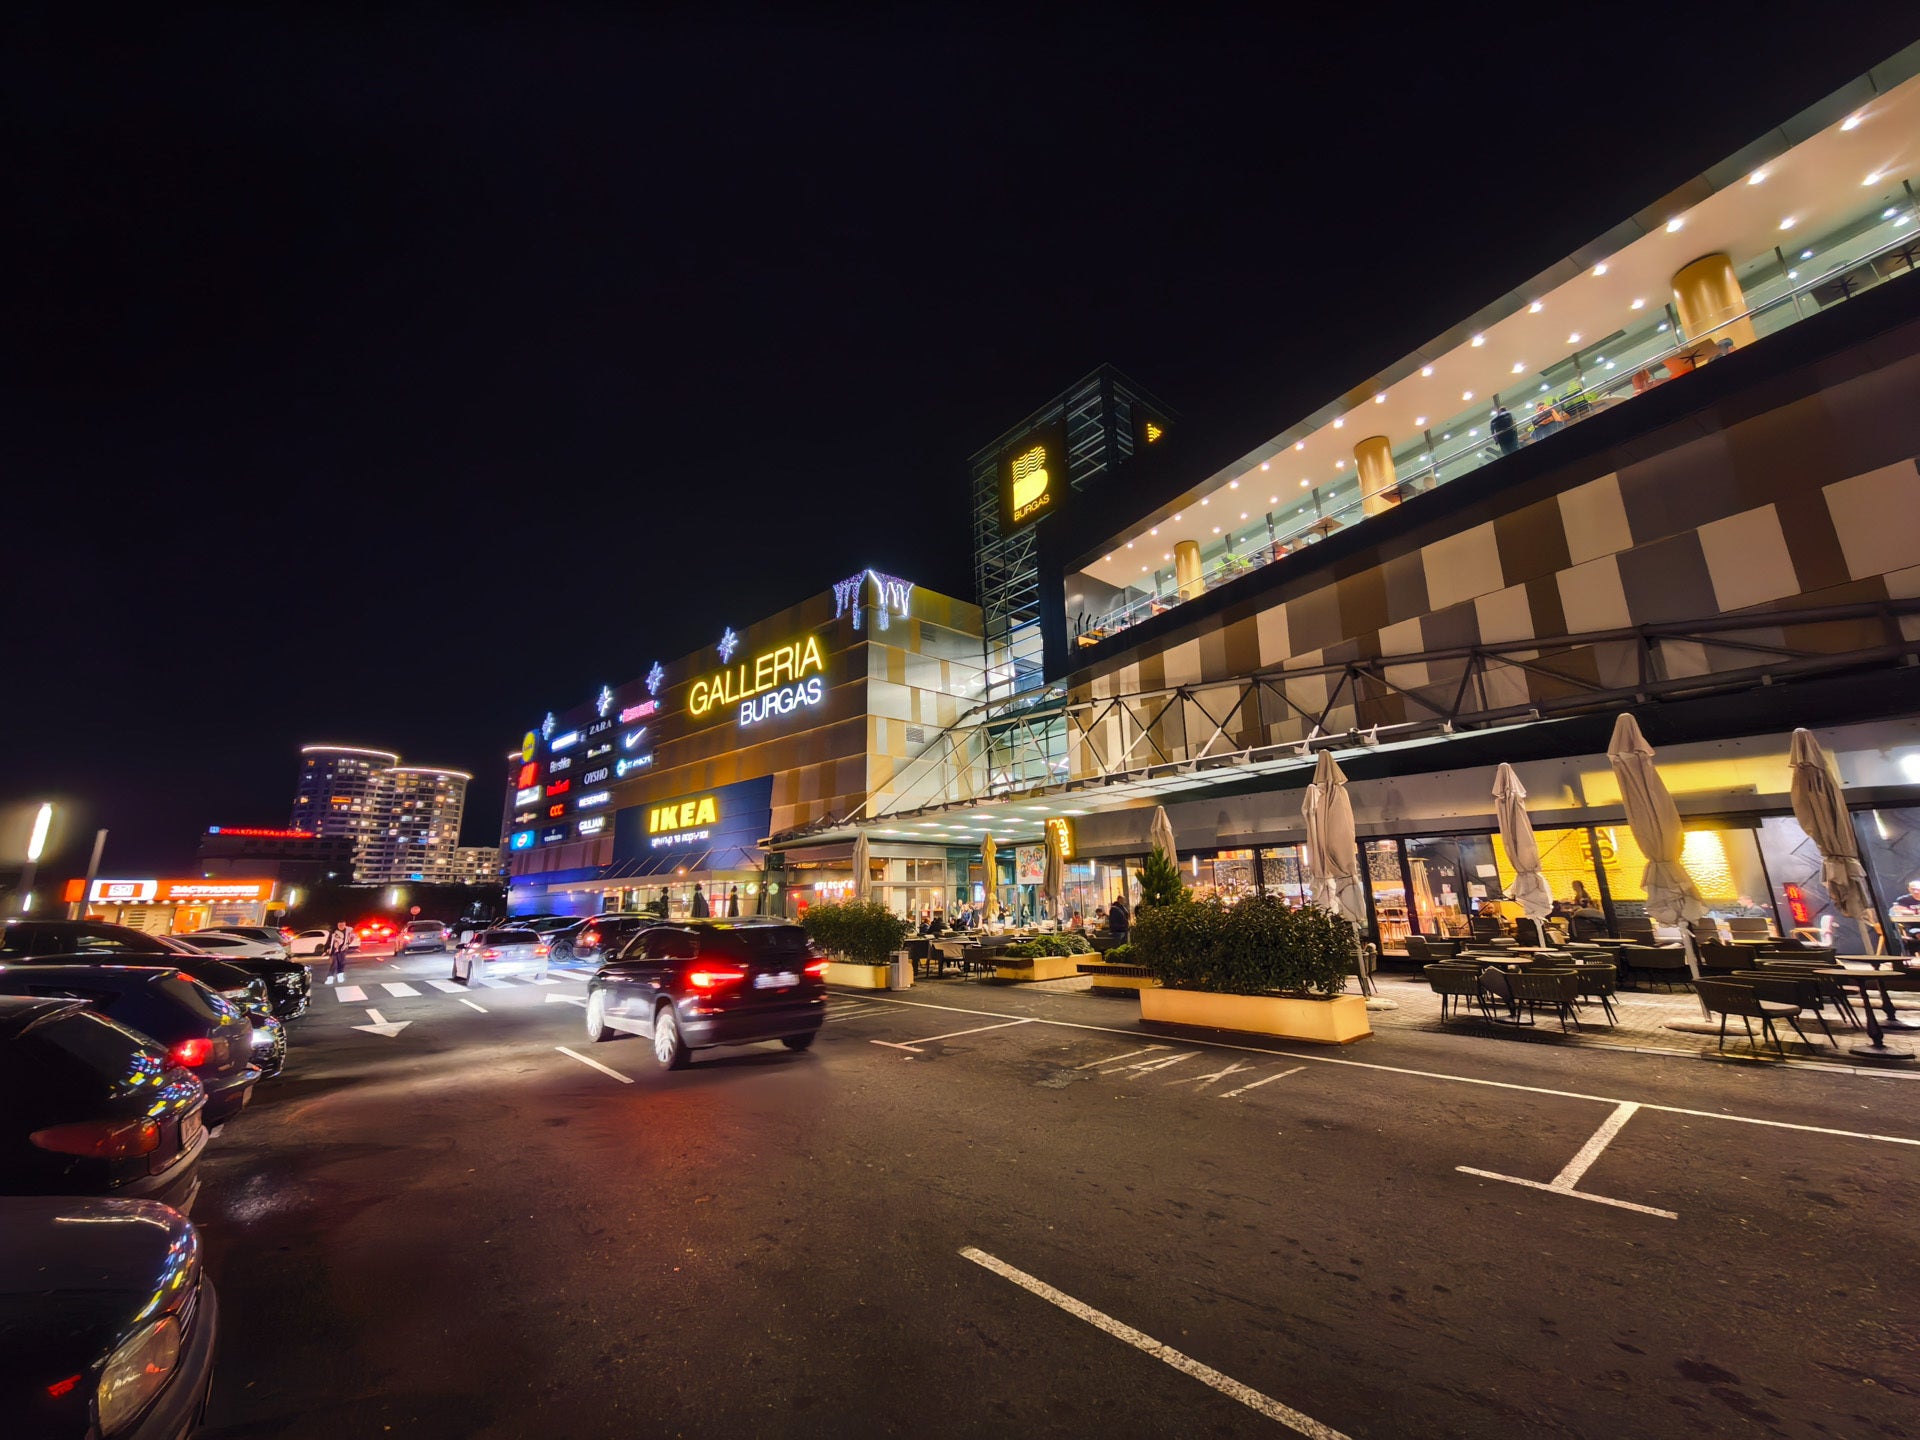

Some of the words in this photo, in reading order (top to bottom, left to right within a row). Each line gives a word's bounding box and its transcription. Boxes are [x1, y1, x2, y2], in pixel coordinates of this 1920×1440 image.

[1014, 494, 1050, 522] BURGAS
[689, 637, 822, 715] GALLERIA
[740, 678, 822, 726] BURGAS
[589, 719, 612, 735] ZARA
[549, 757, 572, 774] Bershka
[584, 767, 608, 785] OYSHO
[549, 804, 564, 817] CCC
[649, 797, 716, 833] IKEA
